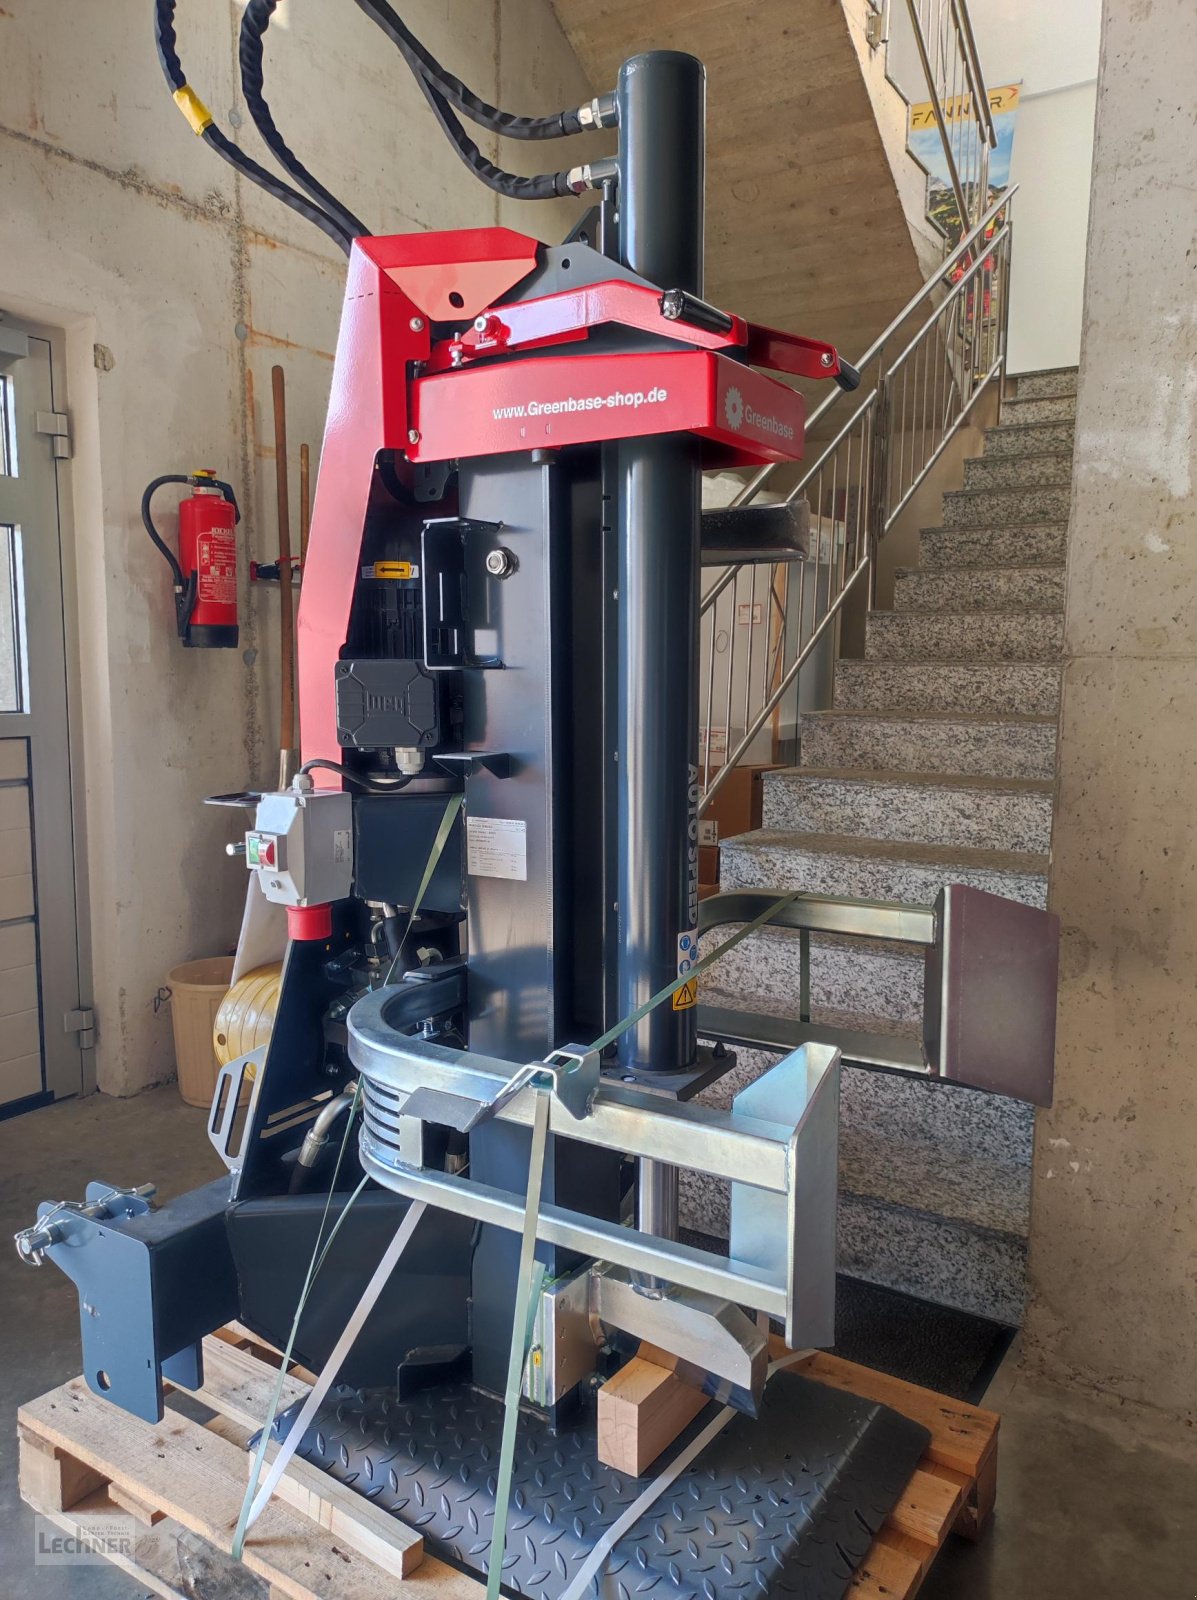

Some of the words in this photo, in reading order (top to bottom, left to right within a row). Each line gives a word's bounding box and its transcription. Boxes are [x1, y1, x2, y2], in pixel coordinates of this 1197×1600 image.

[912, 97, 1003, 126] FANNR
[493, 387, 667, 419] www.Greenbase-shop.de
[745, 404, 794, 440] Greenbase
